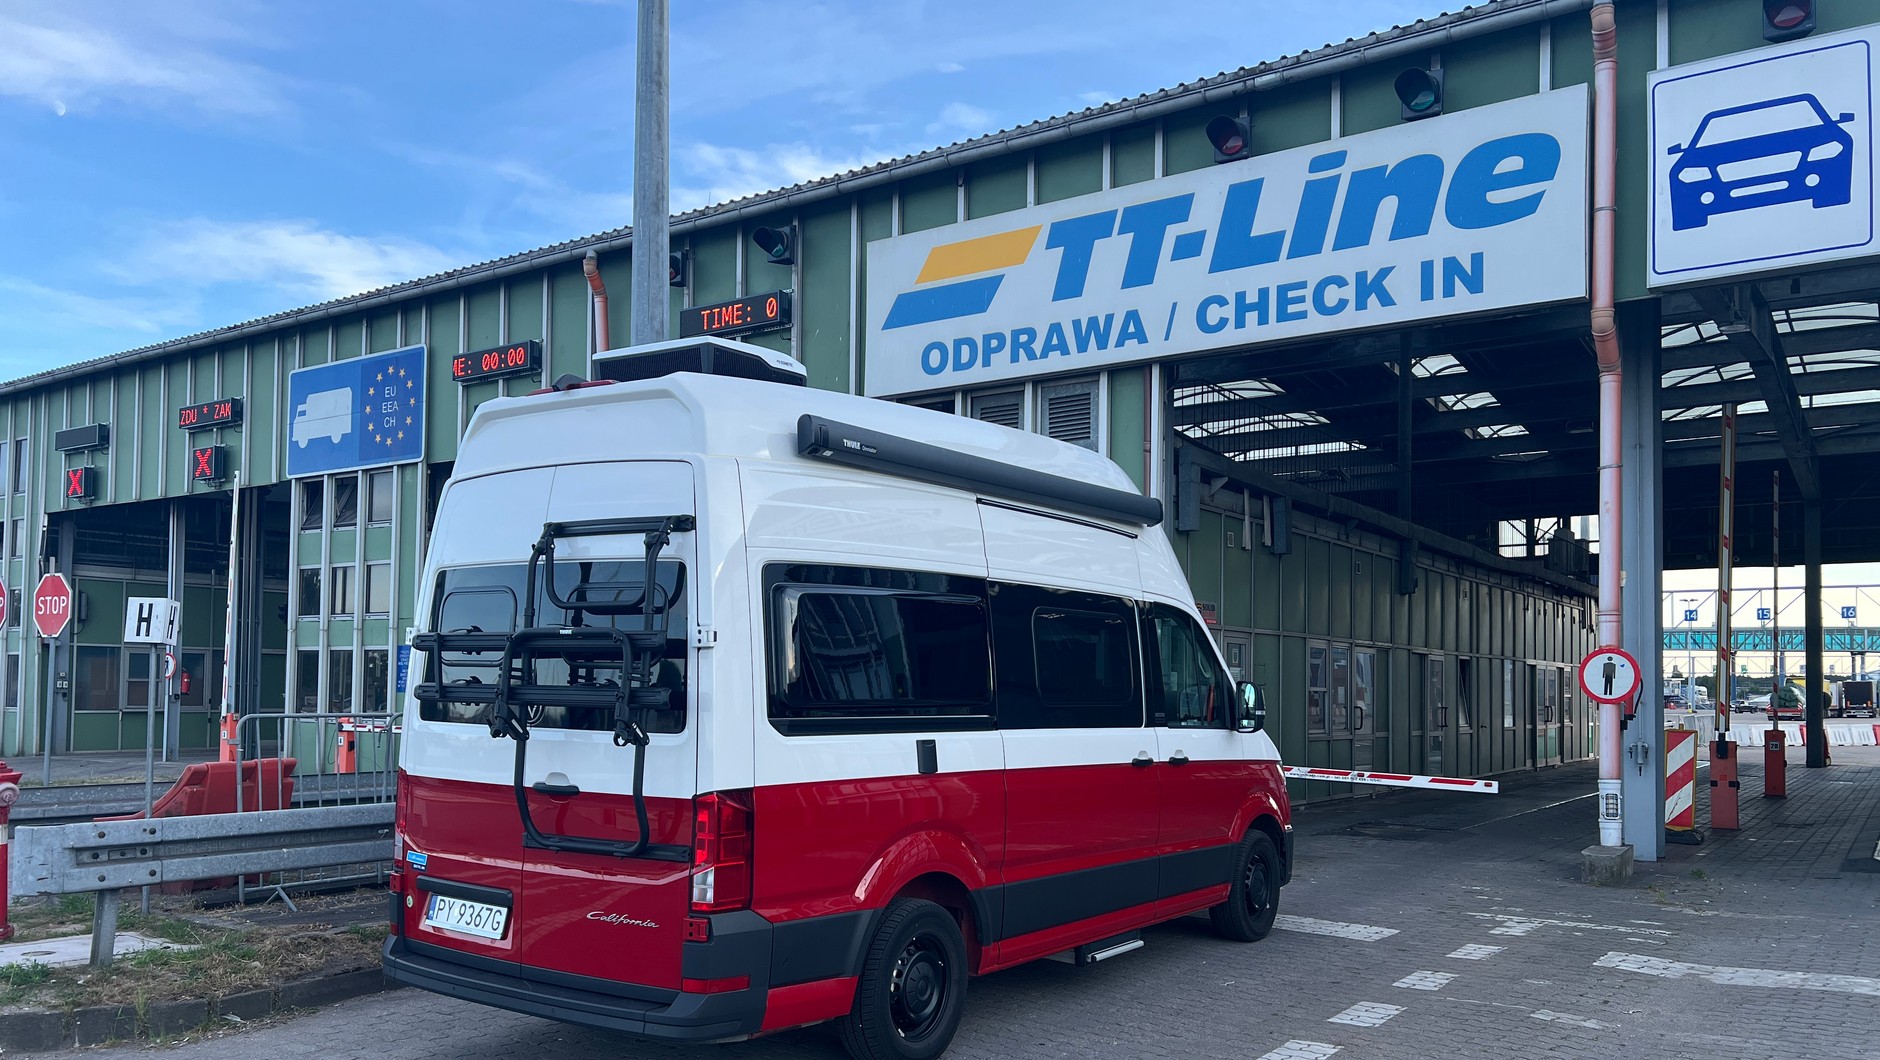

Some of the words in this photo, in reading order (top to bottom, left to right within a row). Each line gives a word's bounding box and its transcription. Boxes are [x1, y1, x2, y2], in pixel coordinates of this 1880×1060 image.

[1045, 132, 1562, 302] TT-Line
[700, 303, 752, 331] TIME:
[765, 297, 778, 319] 0
[920, 309, 1149, 376] ODPRAWA
[1163, 301, 1178, 342] /
[1195, 265, 1398, 334] CHECK
[1420, 251, 1485, 302] IN
[481, 346, 525, 372] 00:00
[384, 385, 397, 398] EU
[381, 400, 399, 413] EEA
[180, 408, 198, 426] ZDU
[383, 415, 396, 428] CH
[37, 596, 67, 615] STOP
[1757, 609, 1770, 620] 15
[1842, 607, 1855, 617] 16
[135, 602, 154, 637] H
[1685, 610, 1698, 620] 14
[435, 898, 456, 922] PY
[456, 902, 503, 932] 9367G
[586, 911, 660, 928] California
